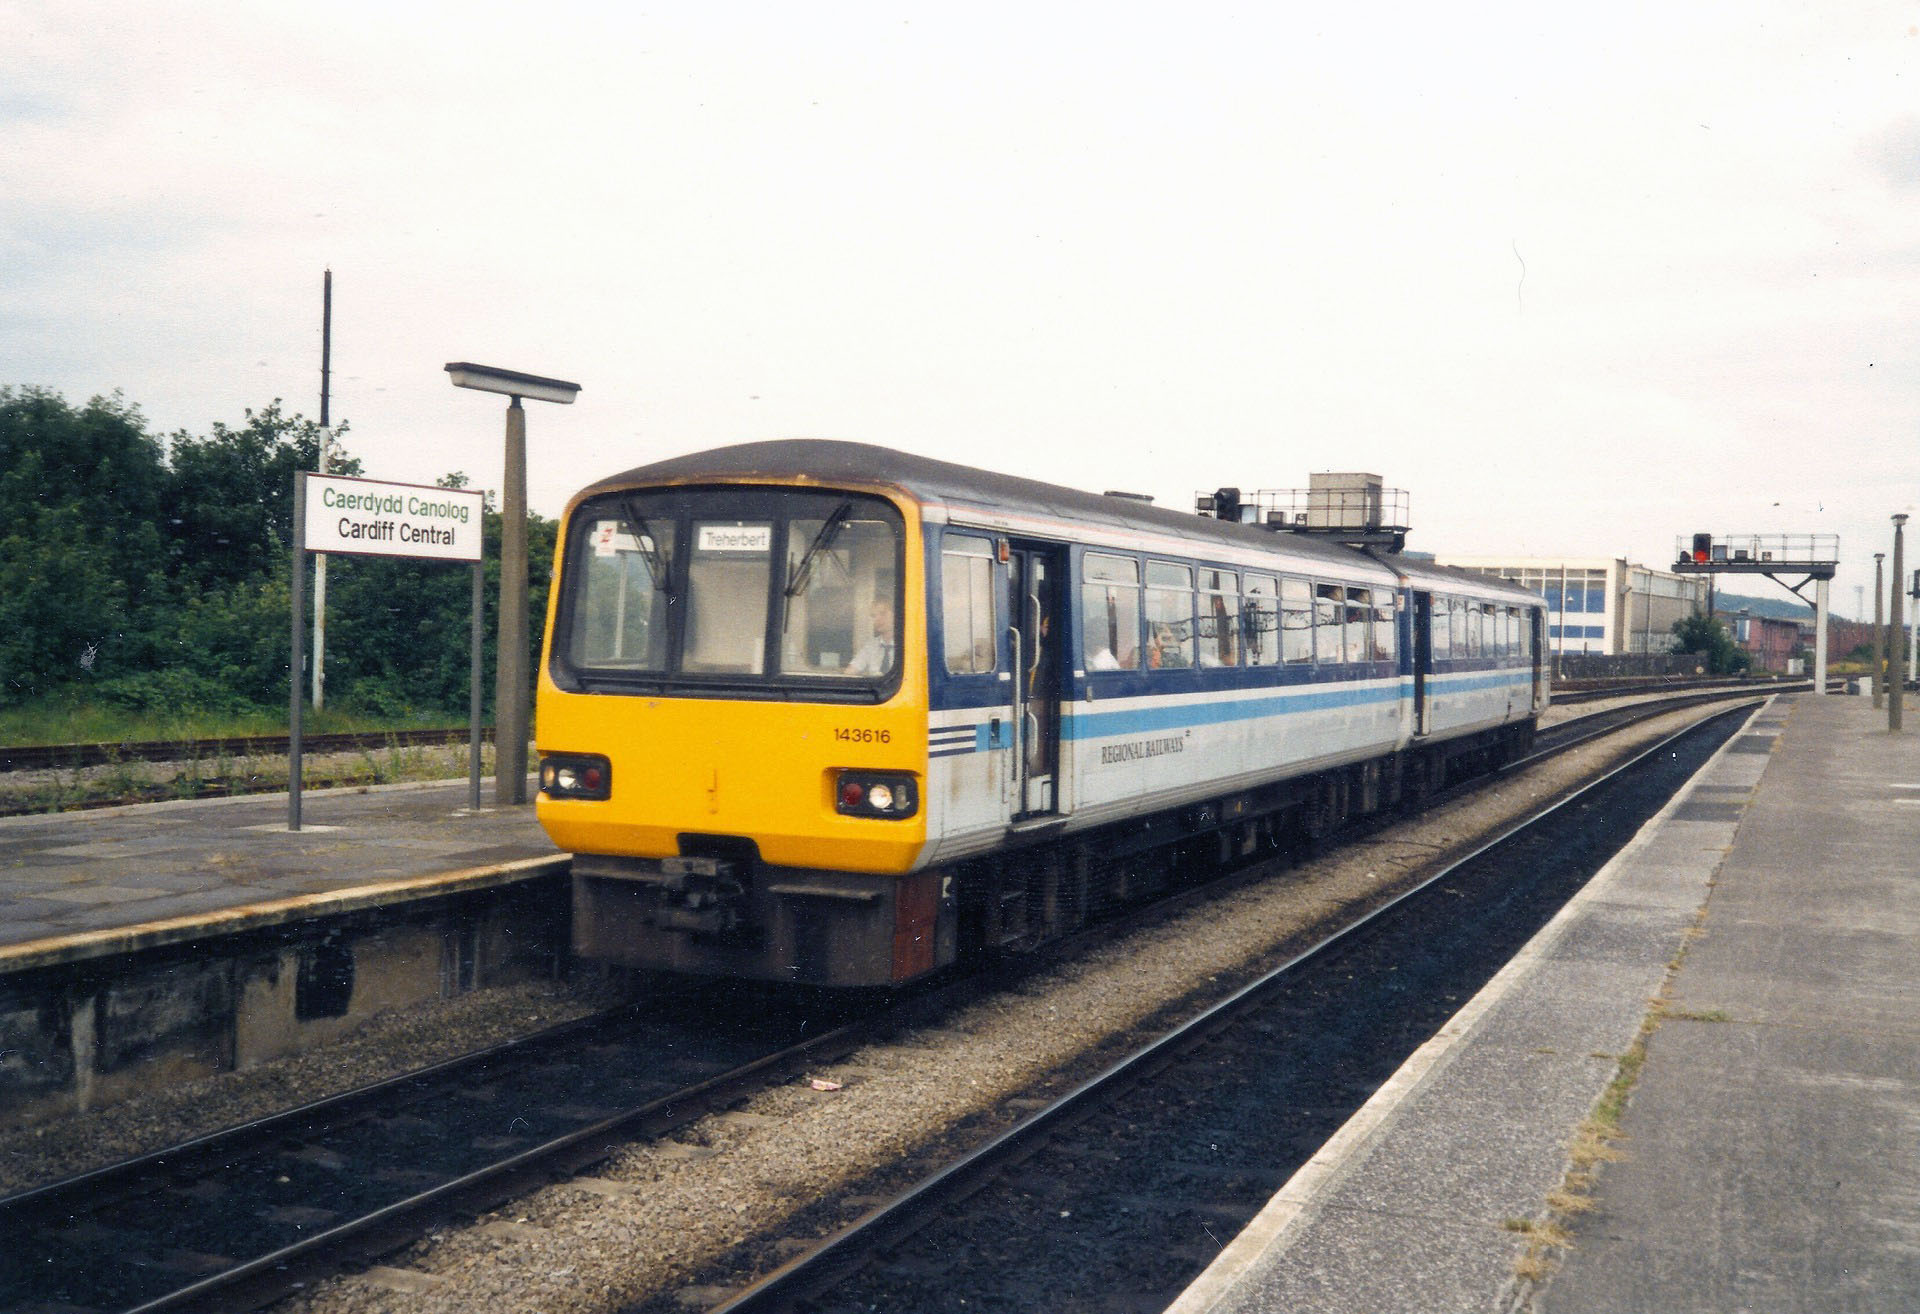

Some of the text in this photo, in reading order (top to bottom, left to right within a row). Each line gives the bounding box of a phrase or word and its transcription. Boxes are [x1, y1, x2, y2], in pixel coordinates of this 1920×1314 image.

[323, 487, 469, 524] Caerdydd Canolog
[338, 517, 455, 546] Cardiff Central
[706, 532, 767, 547] Treherbert
[834, 728, 891, 743] 143616
[1101, 737, 1184, 764] REGIONAL RAILWAYS
